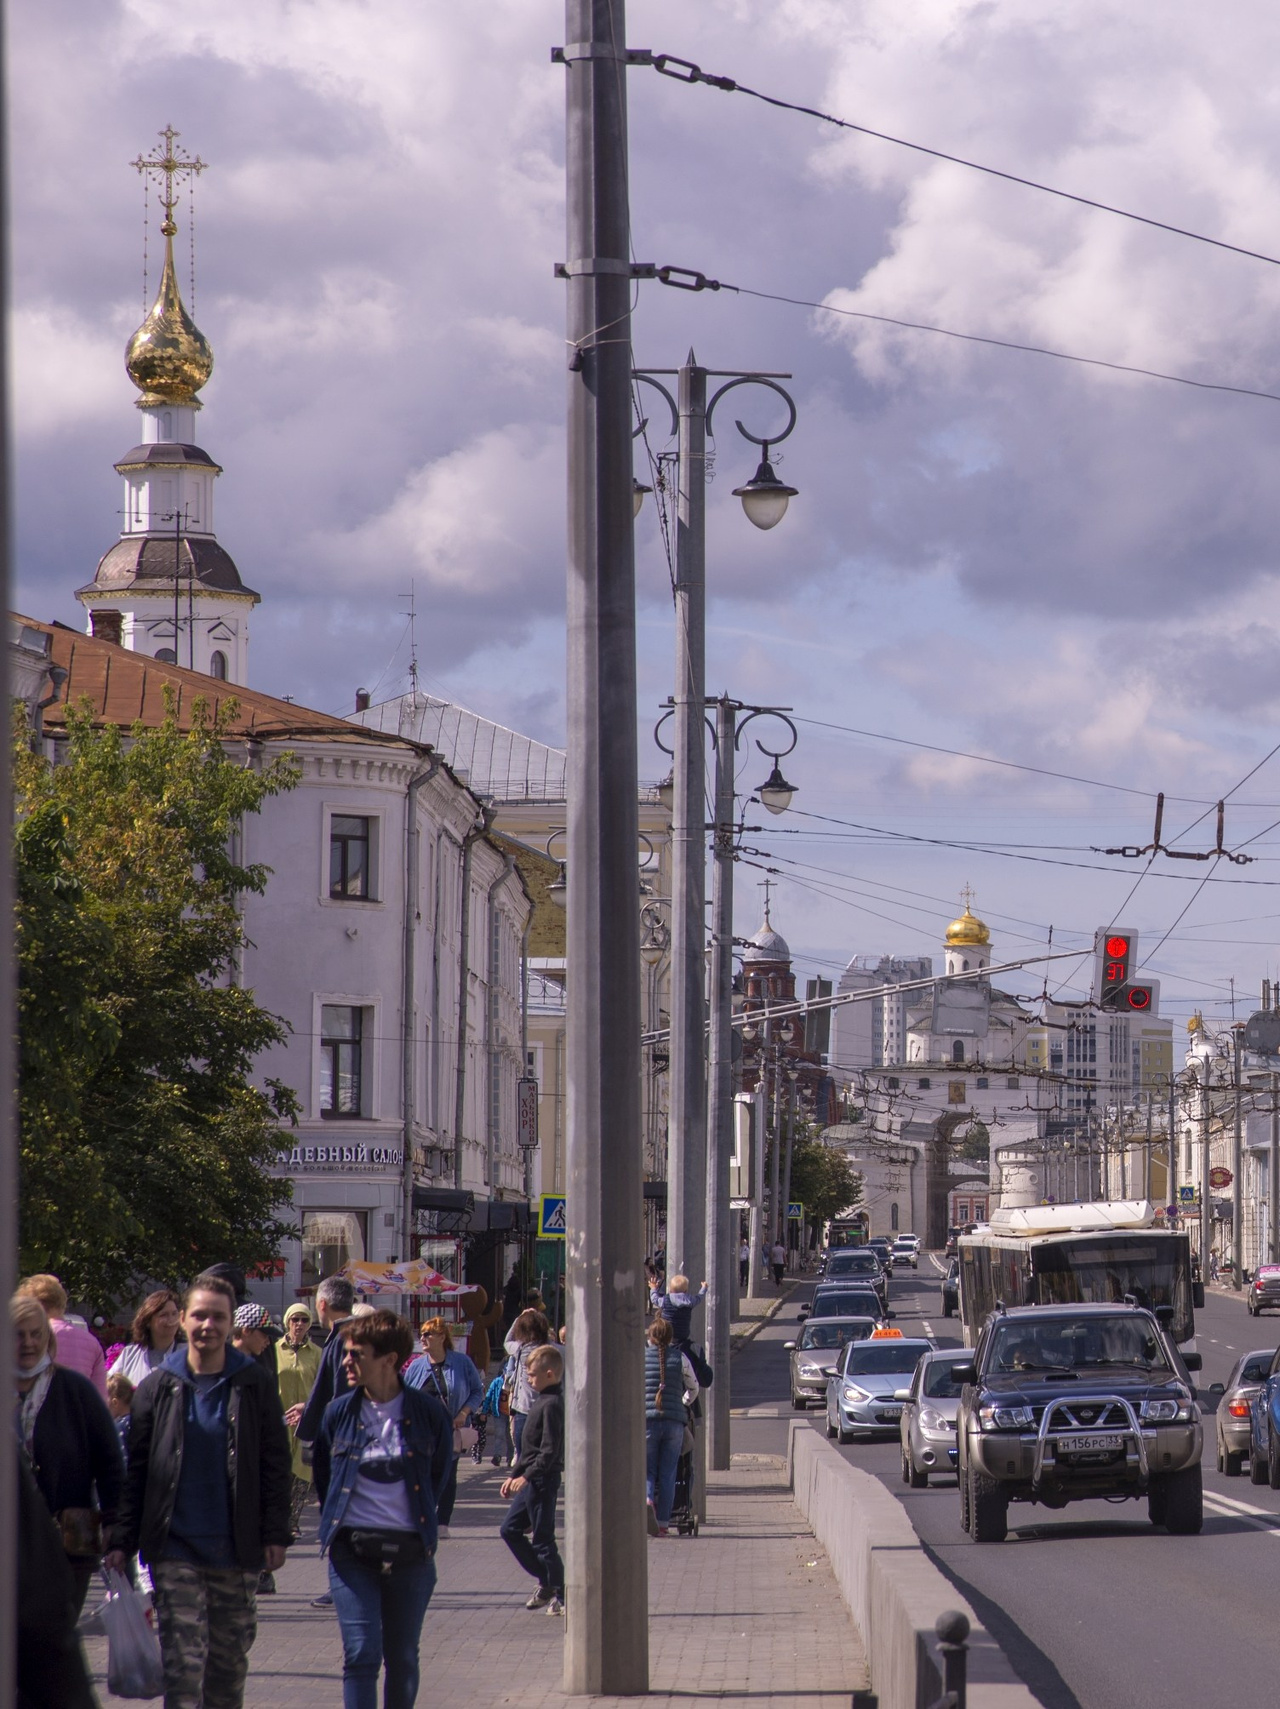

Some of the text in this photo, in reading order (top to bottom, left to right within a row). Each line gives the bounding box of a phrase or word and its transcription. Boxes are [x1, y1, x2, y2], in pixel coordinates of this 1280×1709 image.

[1107, 963, 1124, 980] 37
[276, 1143, 403, 1165] АДЕБНЫЙ САЛОН
